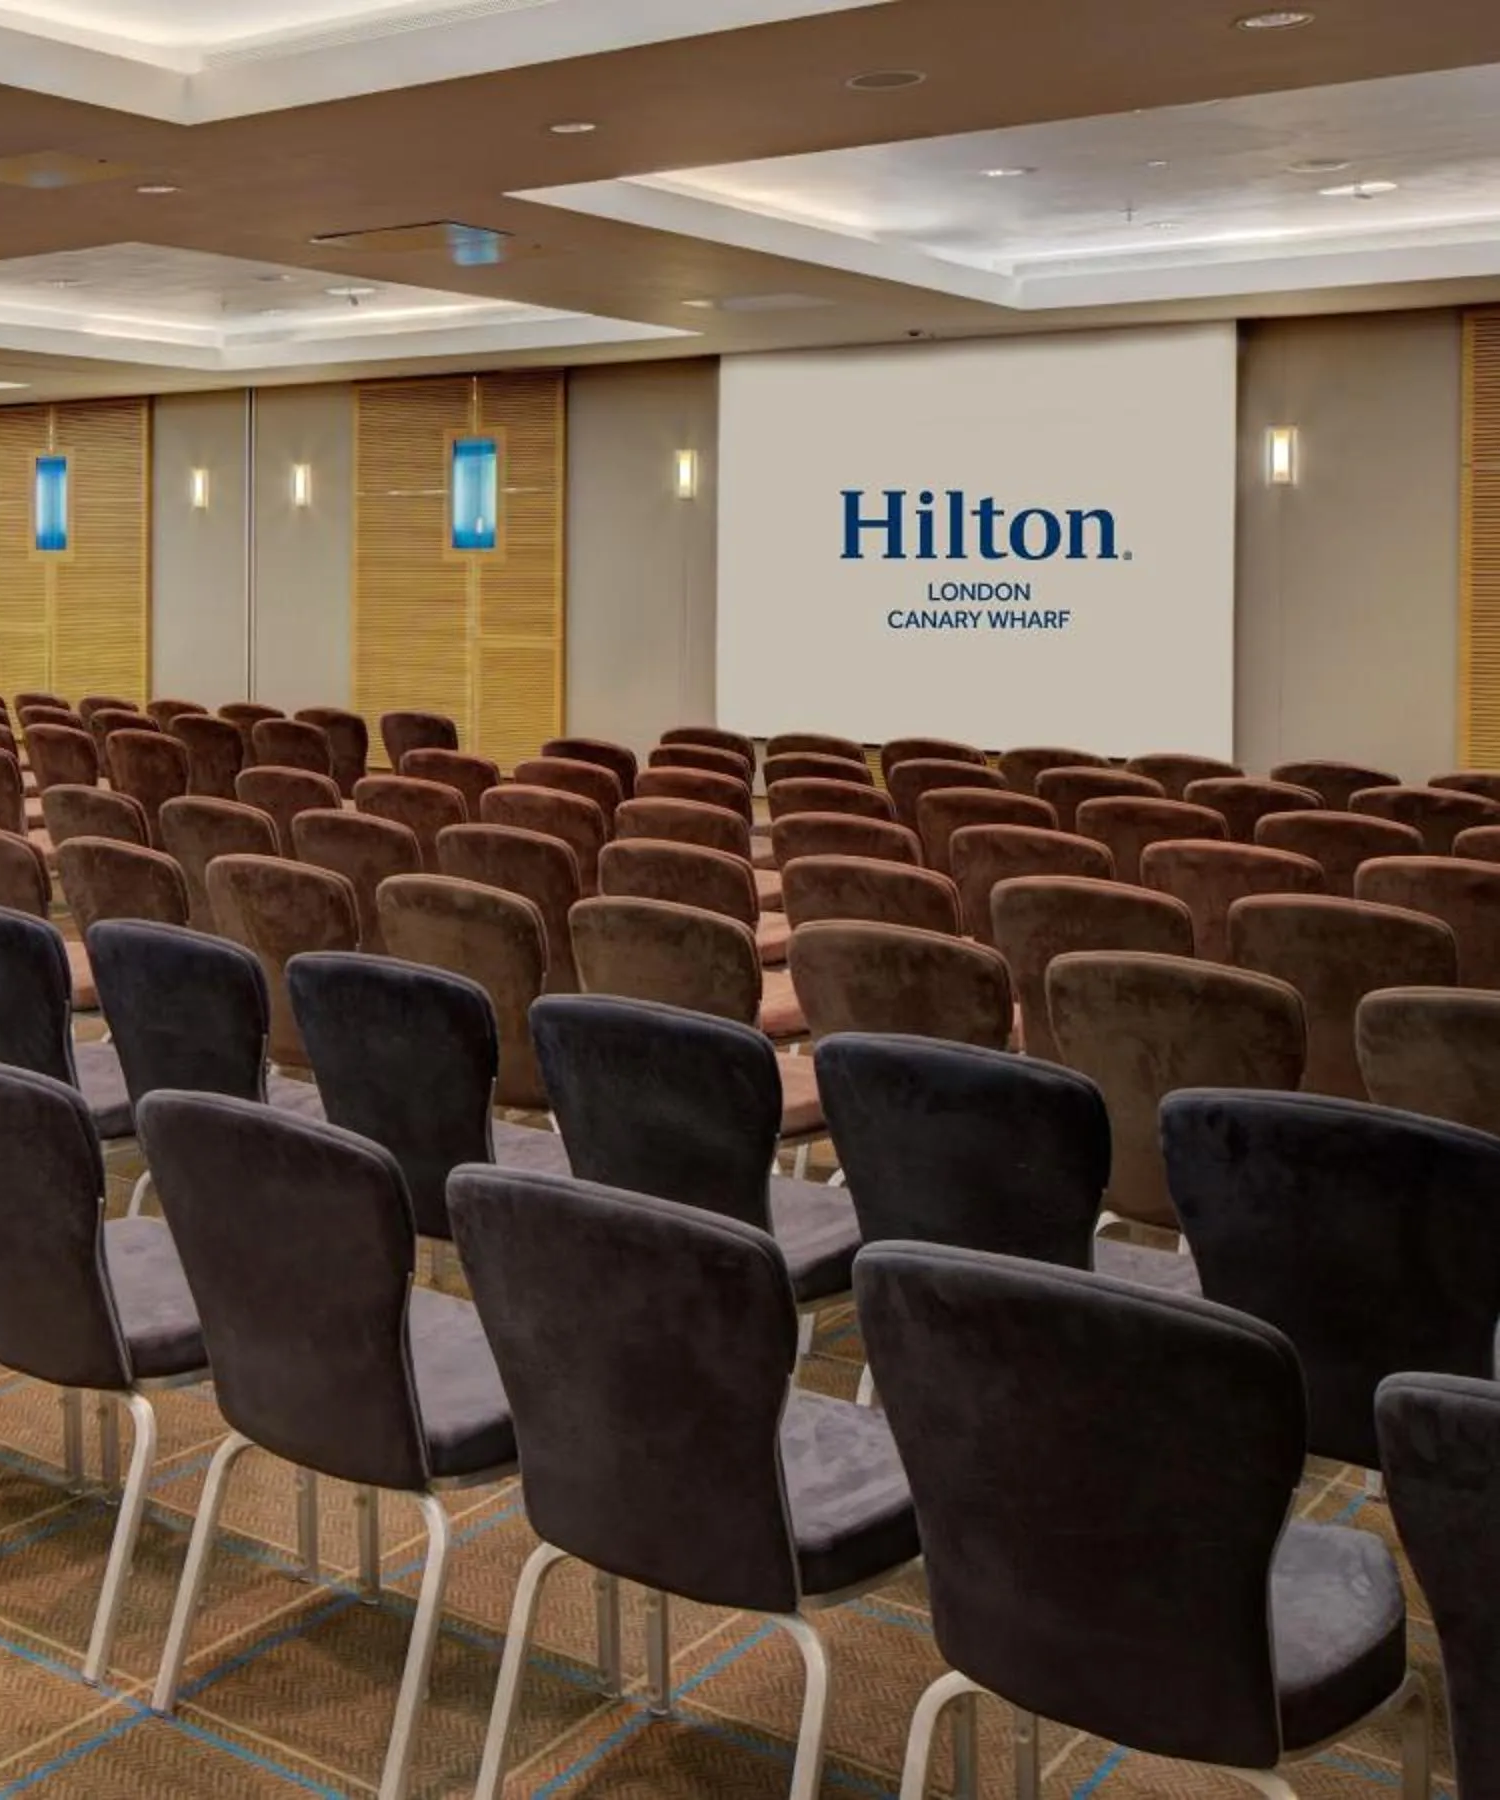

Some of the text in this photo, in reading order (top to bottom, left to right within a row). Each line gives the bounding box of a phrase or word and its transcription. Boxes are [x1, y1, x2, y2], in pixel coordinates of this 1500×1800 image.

[839, 489, 1119, 561] Hilton
[927, 581, 1031, 602] LONDON
[887, 609, 1071, 629] CANARY WHARF
